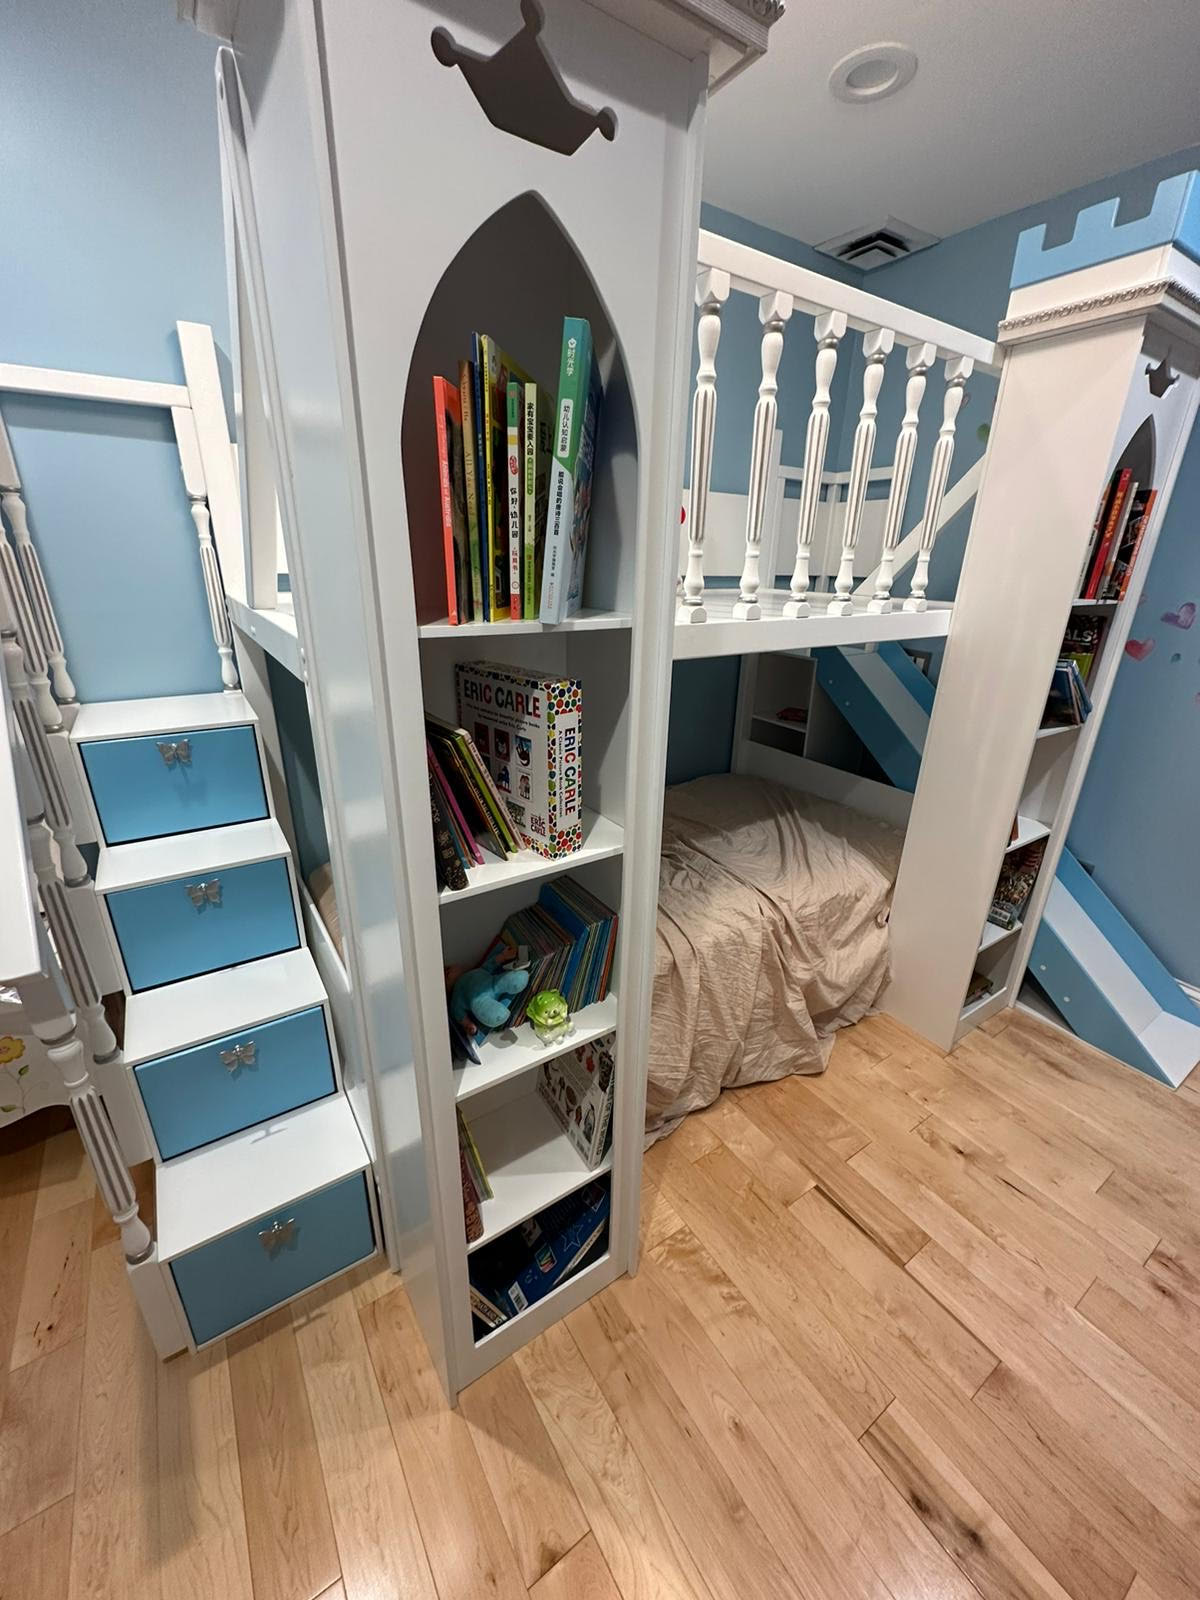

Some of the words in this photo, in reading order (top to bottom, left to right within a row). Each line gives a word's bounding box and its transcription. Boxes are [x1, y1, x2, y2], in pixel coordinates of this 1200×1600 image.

[565, 348, 576, 377] 时光学
[560, 405, 571, 453] 幼儿认知启蒙
[441, 460, 450, 488] Animals
[465, 451, 473, 466] All
[463, 680, 492, 705] ERIC
[495, 686, 541, 719] CARLE
[564, 727, 576, 764] ERIC
[564, 765, 577, 817] CARLE
